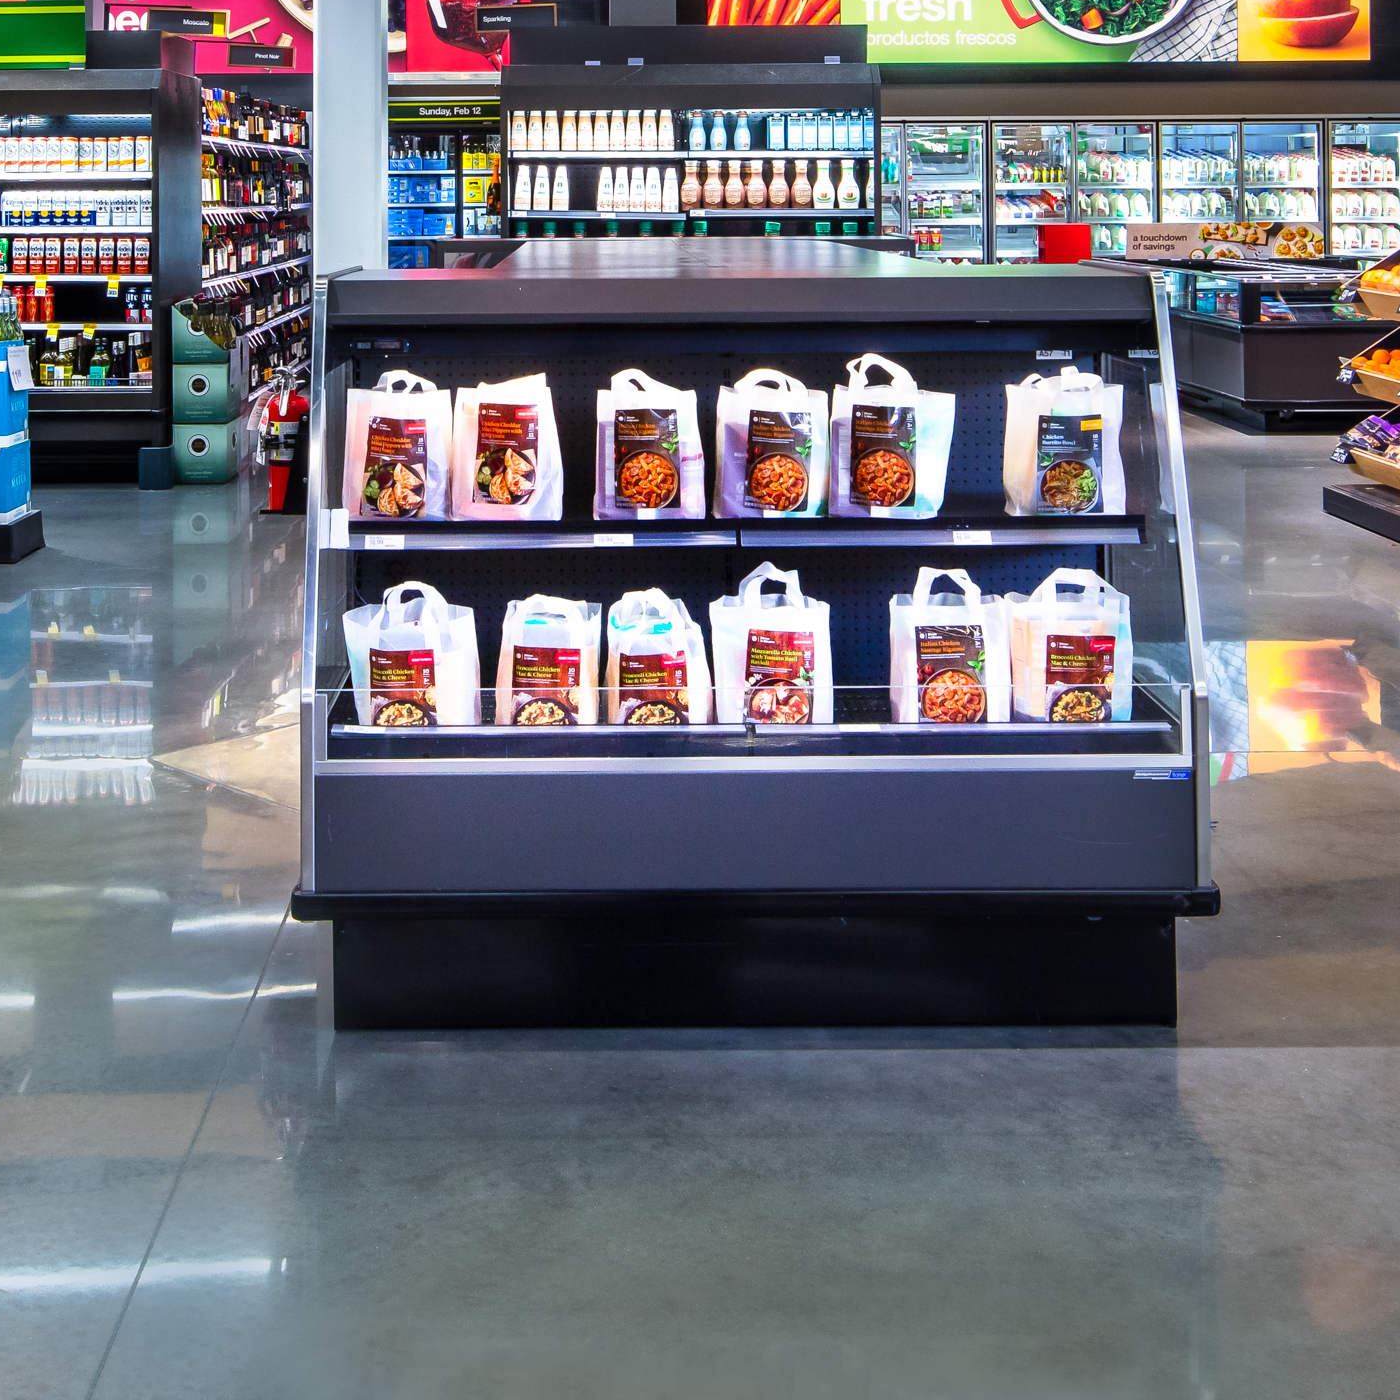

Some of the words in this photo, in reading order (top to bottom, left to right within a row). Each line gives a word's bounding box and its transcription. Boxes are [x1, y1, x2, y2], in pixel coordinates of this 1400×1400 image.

[183, 18, 210, 26] Moscato
[483, 15, 512, 24] Sparkling
[955, 30, 1017, 46] frescos
[419, 107, 452, 117] Sunday,
[453, 107, 470, 115] Feb
[472, 107, 481, 115] 12
[1140, 234, 1188, 242] touchdown
[1133, 243, 1142, 251] of
[1143, 243, 1175, 252] savings
